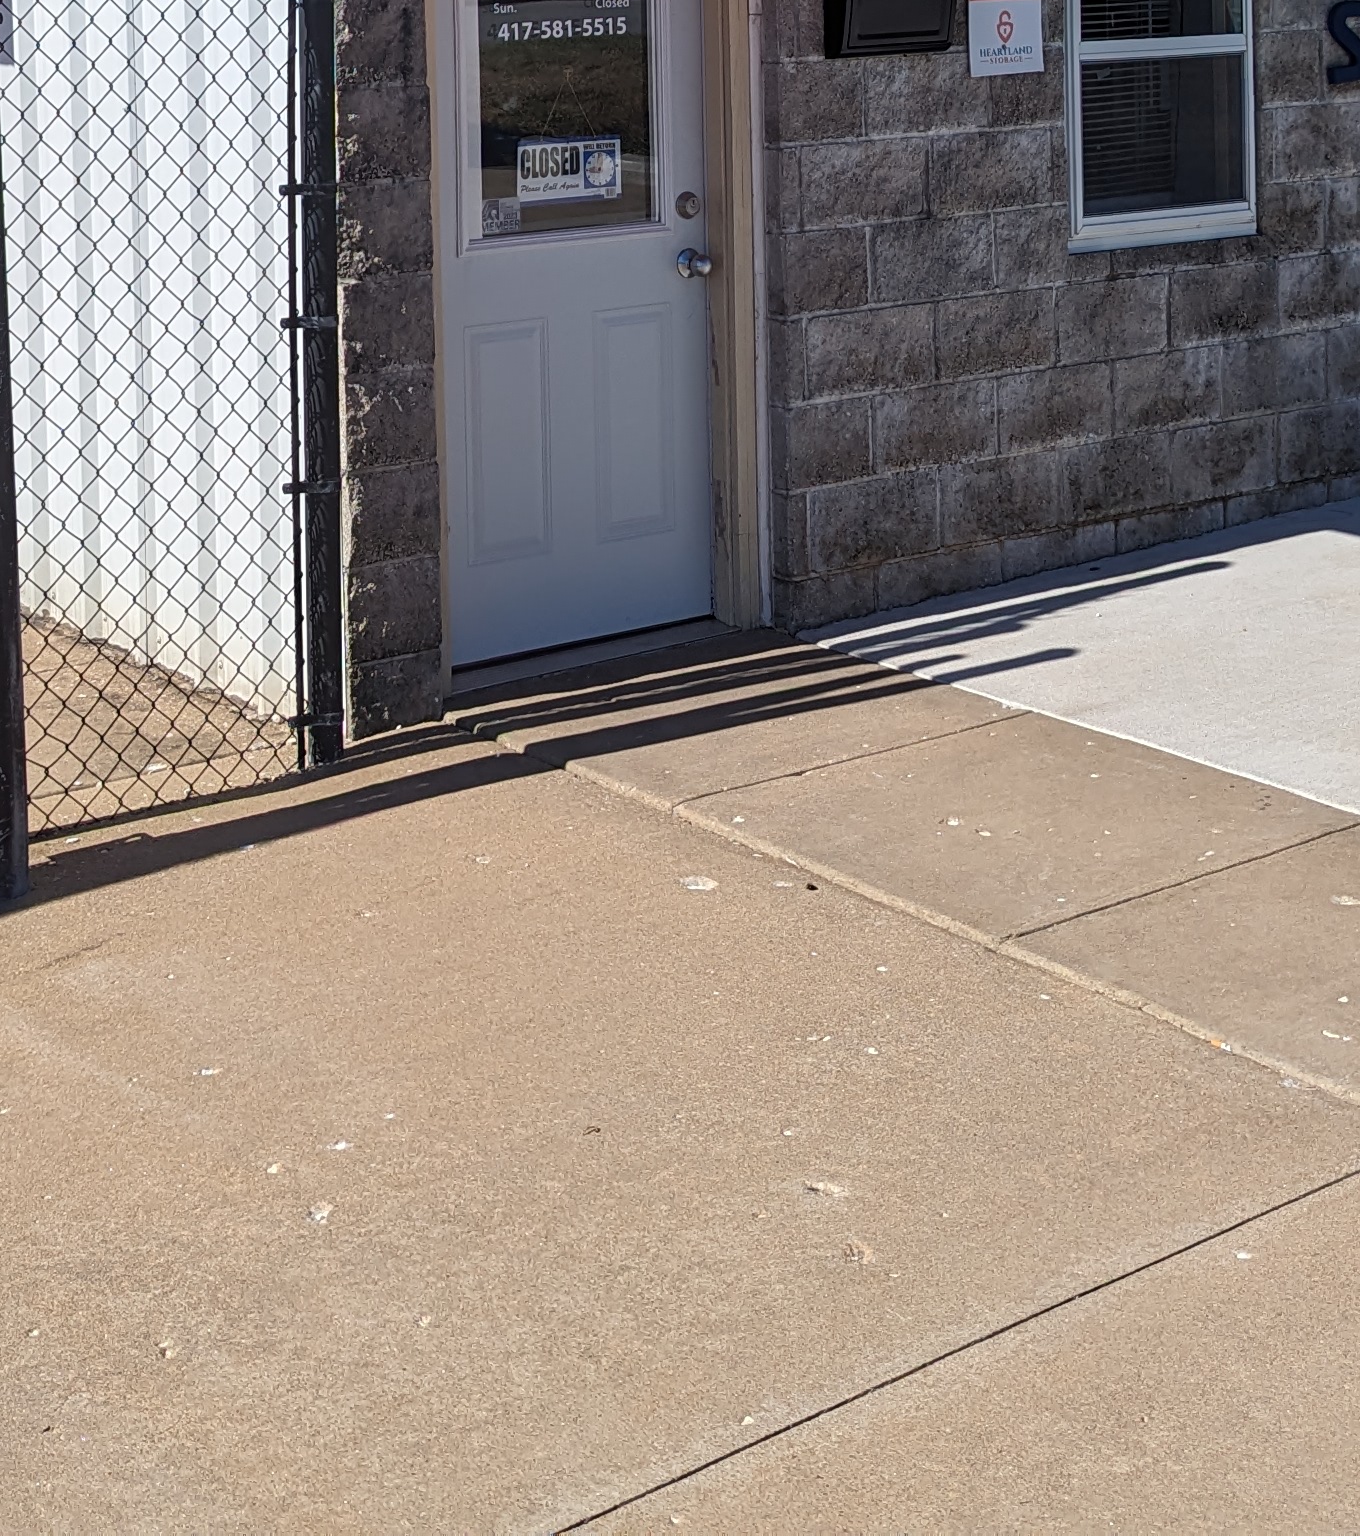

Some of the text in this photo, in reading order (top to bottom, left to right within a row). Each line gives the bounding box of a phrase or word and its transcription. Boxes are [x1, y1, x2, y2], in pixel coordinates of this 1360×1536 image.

[493, 2, 518, 14] Sun.
[497, 16, 627, 42] 417-581-5515
[979, 45, 1033, 58] HEARTLAND
[989, 55, 1024, 64] STORAGE
[595, 142, 616, 150] RETURN
[520, 145, 581, 180] CLOSED
[520, 181, 580, 193] Please Call Again
[482, 219, 520, 233] MEMBER
